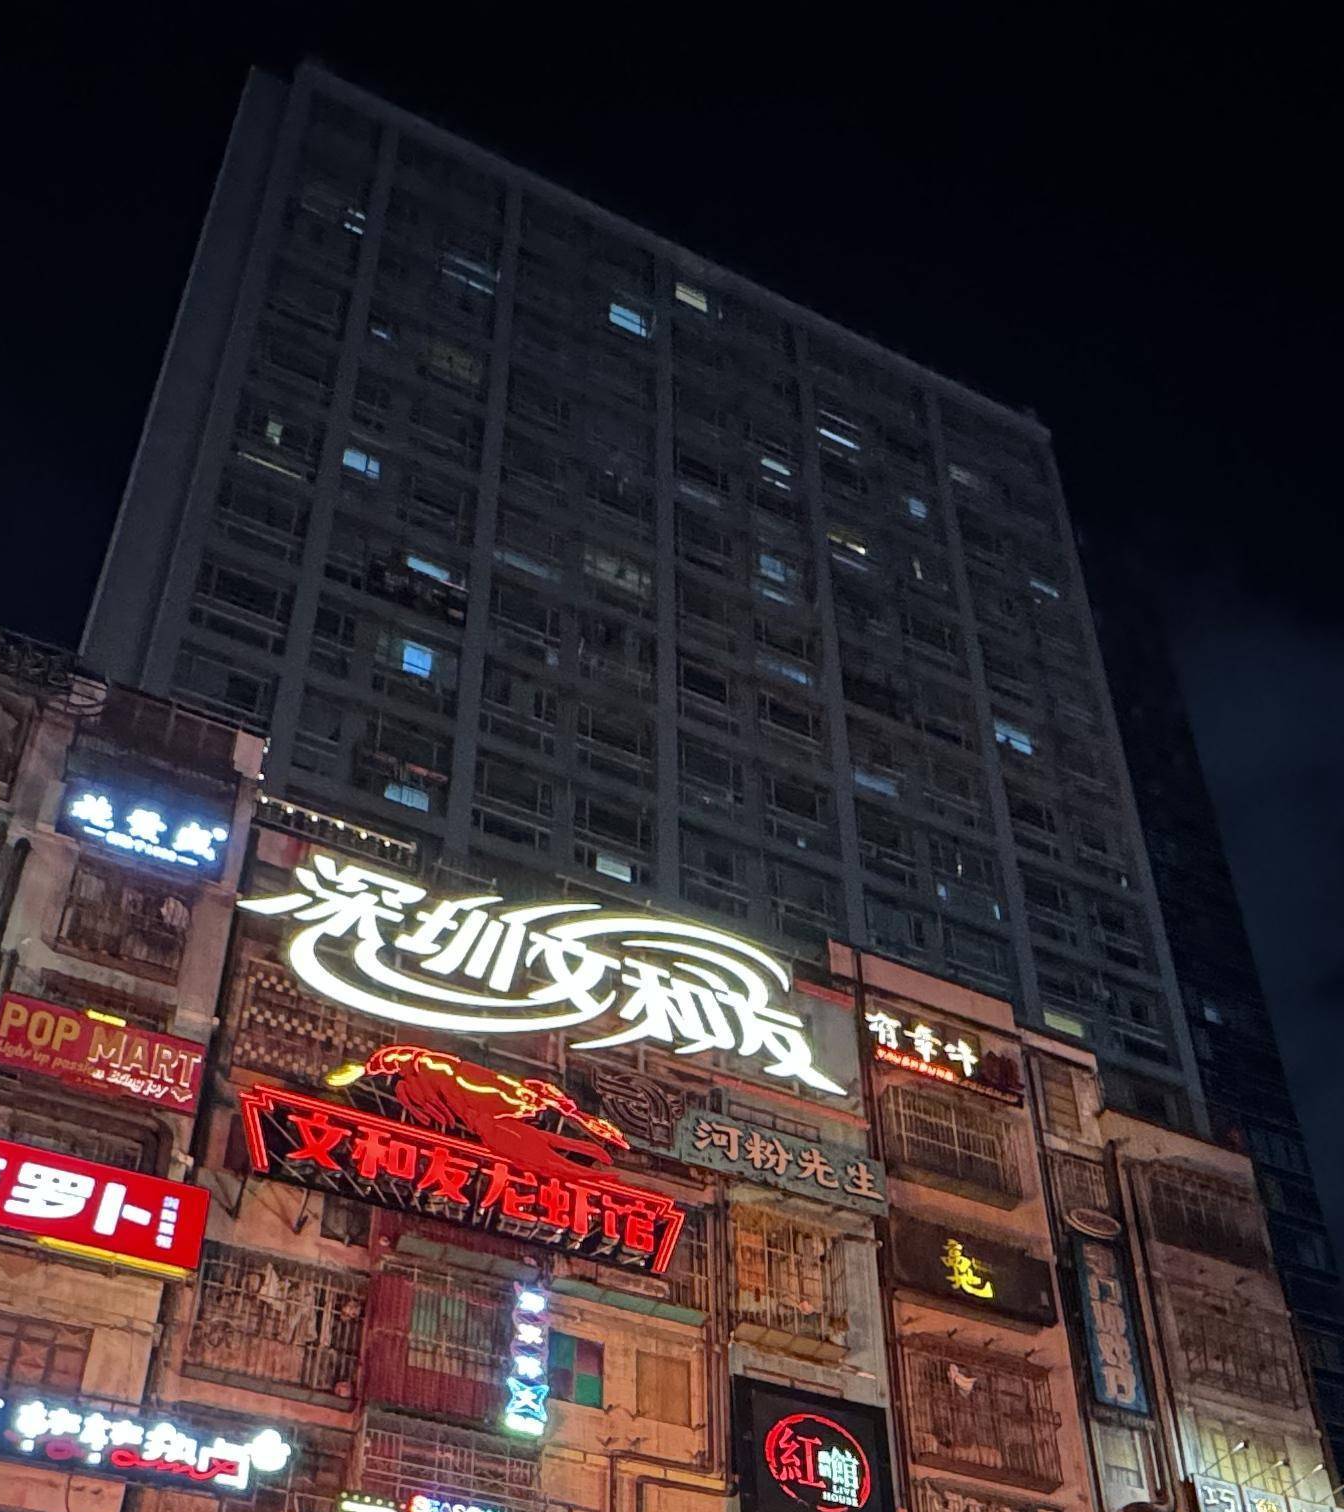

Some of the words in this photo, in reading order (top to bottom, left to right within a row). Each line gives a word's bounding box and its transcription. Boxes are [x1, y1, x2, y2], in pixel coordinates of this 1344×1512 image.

[236, 853, 848, 1096] 深圳文和友
[87, 1026, 202, 1088] MART
[286, 1112, 658, 1254] 文和友龙虾馆
[693, 1119, 884, 1201] 河粉先生
[822, 1491, 859, 1508] HOUSE
[832, 1484, 857, 1498] LIVE
